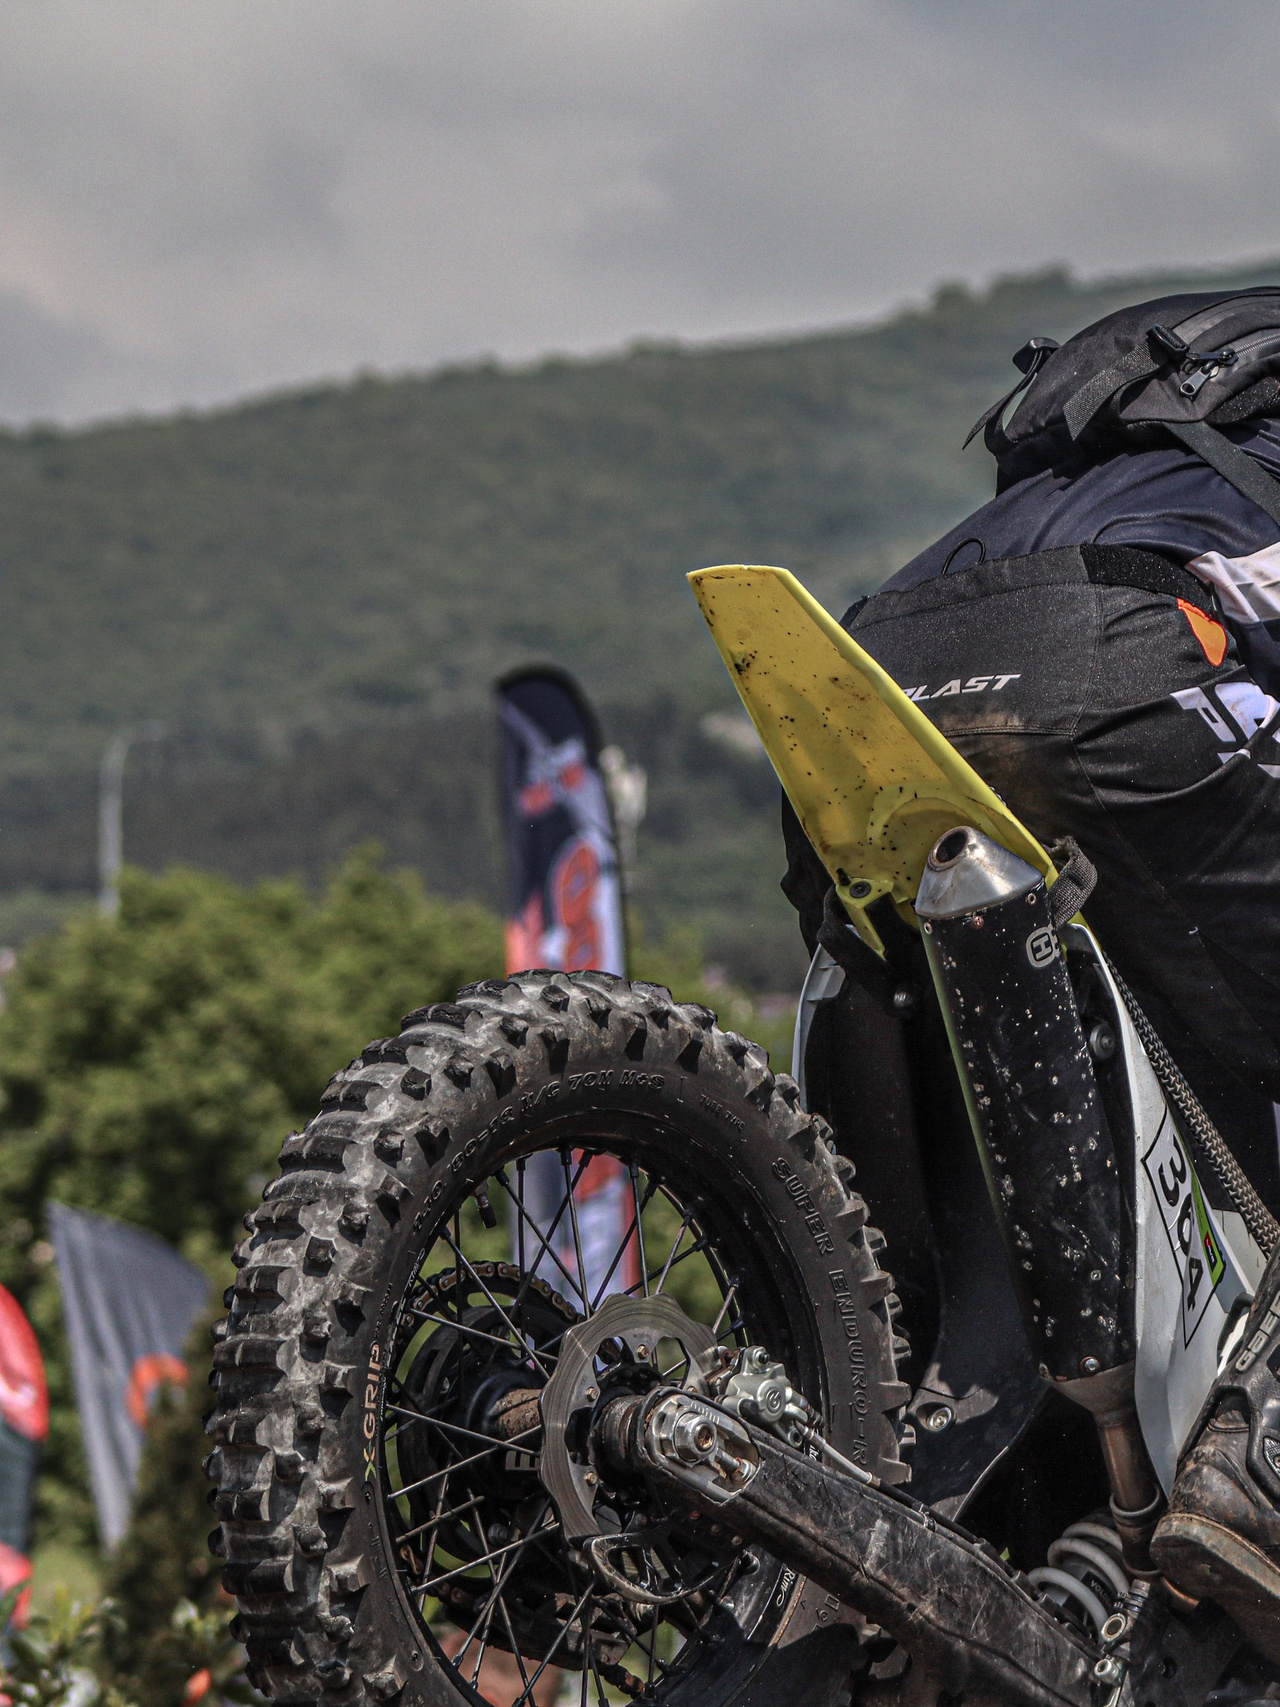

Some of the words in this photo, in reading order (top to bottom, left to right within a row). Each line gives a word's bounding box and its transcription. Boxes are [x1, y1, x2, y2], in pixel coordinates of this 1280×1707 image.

[568, 1069, 614, 1091] 70M
[619, 1069, 666, 1090] M+S
[724, 1109, 746, 1131] TYPE
[771, 1156, 835, 1255] SUPER
[1157, 1134, 1204, 1312] 364
